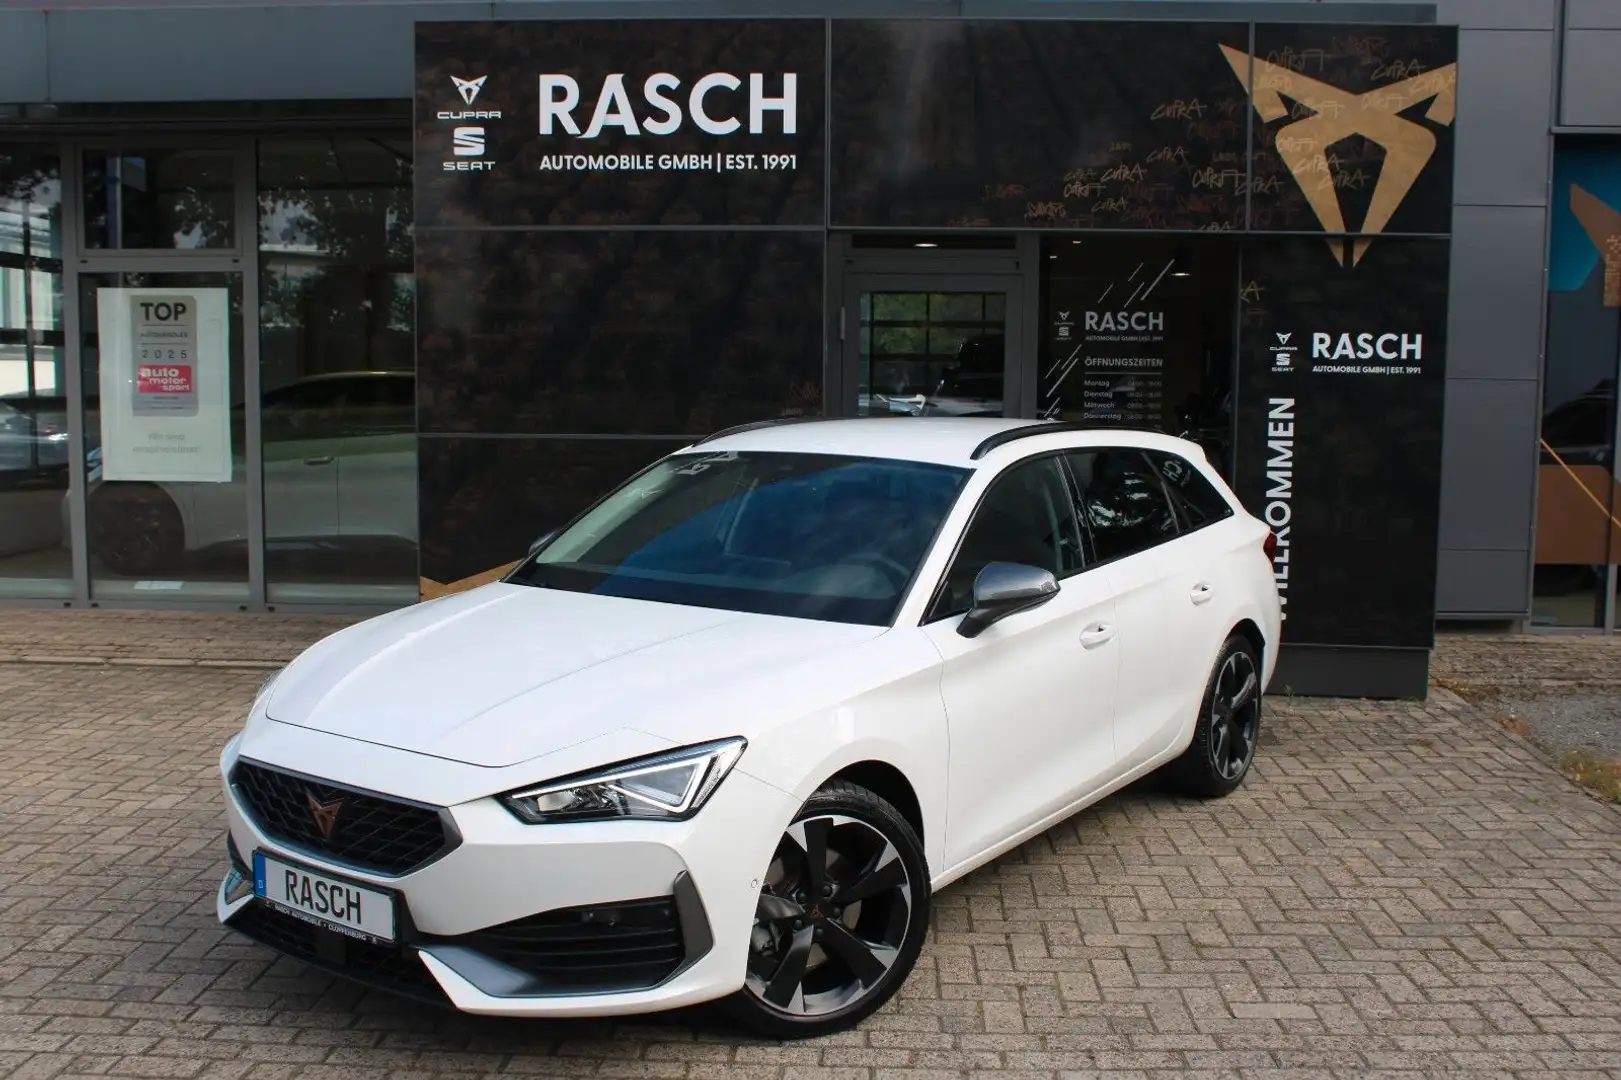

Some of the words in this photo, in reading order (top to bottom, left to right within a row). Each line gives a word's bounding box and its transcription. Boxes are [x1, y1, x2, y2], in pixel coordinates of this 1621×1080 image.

[436, 110, 502, 120] CUPRA
[538, 72, 798, 139] RASCH
[1150, 98, 1207, 121] CUPRA
[442, 160, 496, 171] SEAT
[539, 154, 655, 171] AUTOMOBILE
[658, 154, 713, 171] GMBH
[725, 154, 759, 171] EST.
[761, 154, 798, 171] 1991
[1101, 162, 1148, 182] CUPRA
[139, 302, 187, 322] TOP
[1084, 310, 1164, 332] RASCH
[1312, 332, 1422, 360] RASCH
[1084, 355, 1164, 367] ÖFFNUNGSZEITEN
[1312, 365, 1362, 374] AUTOMOBILE
[1362, 366, 1386, 374] GMBH
[1406, 366, 1422, 375] 1991
[139, 367, 180, 378] auto
[285, 869, 362, 925] RASCH
